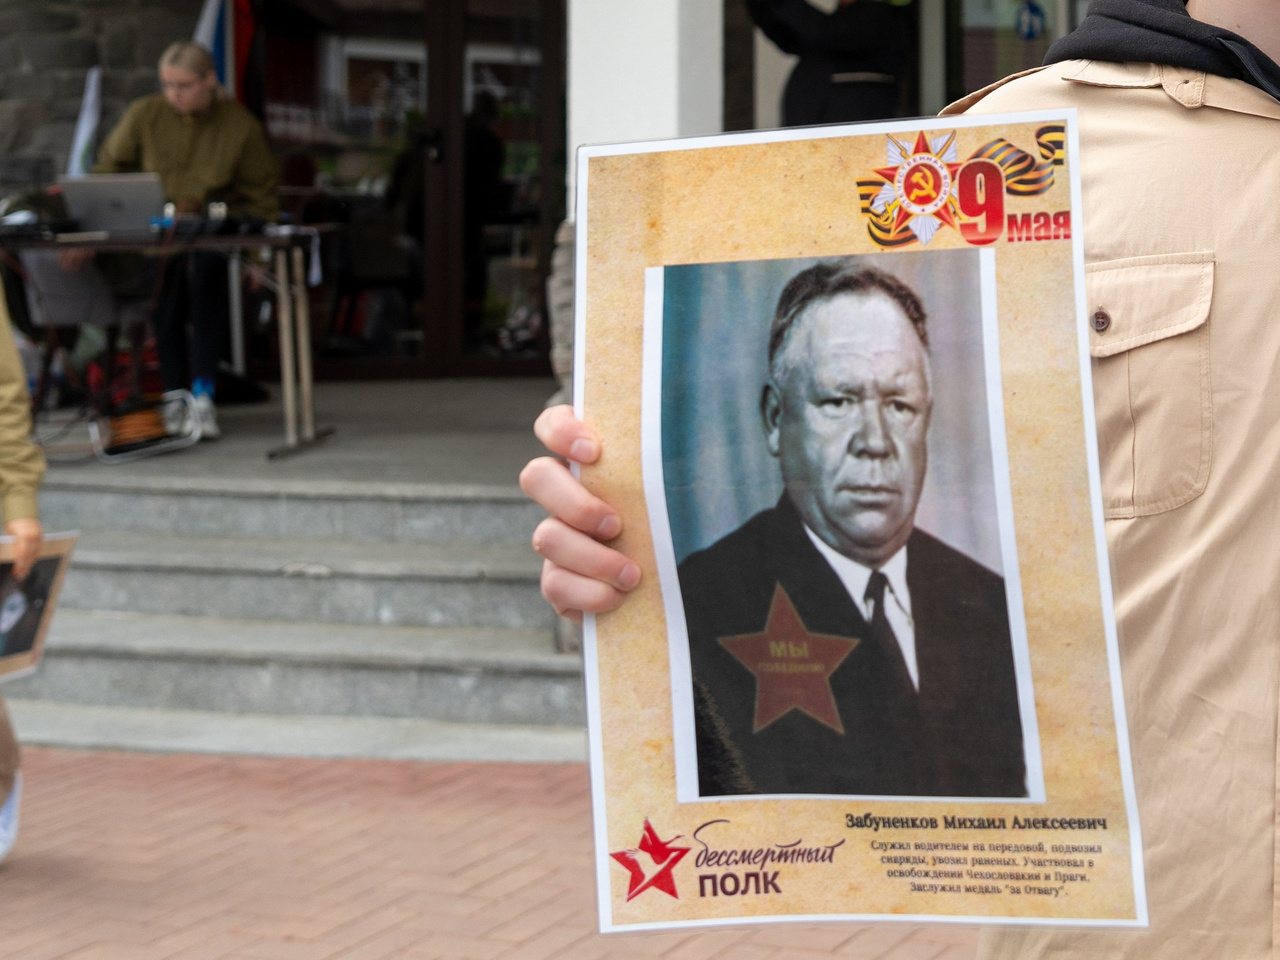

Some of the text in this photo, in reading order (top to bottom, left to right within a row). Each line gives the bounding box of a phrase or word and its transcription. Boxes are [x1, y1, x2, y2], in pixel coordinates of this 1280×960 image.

[958, 160, 1072, 245] 9 мая
[846, 813, 1107, 831] Забуненков Михаил Алексеевич
[693, 818, 846, 869] бессмертный
[871, 840, 910, 852] Служил
[914, 843, 969, 852] водителем
[989, 843, 1047, 854] передовой,
[1051, 845, 1102, 853] подвозил
[881, 855, 929, 865] снаряды,
[932, 857, 968, 867] увозил
[972, 857, 1019, 867] раненых.
[1023, 857, 1084, 867] Участвовал
[699, 870, 782, 897] ПОЛК
[887, 868, 963, 880] освобождении
[967, 870, 1041, 880] Чехословакии
[1055, 872, 1090, 883] Праги.
[910, 882, 961, 893] Заслужил
[965, 885, 1002, 894] медаль
[1005, 884, 1021, 894] "за
